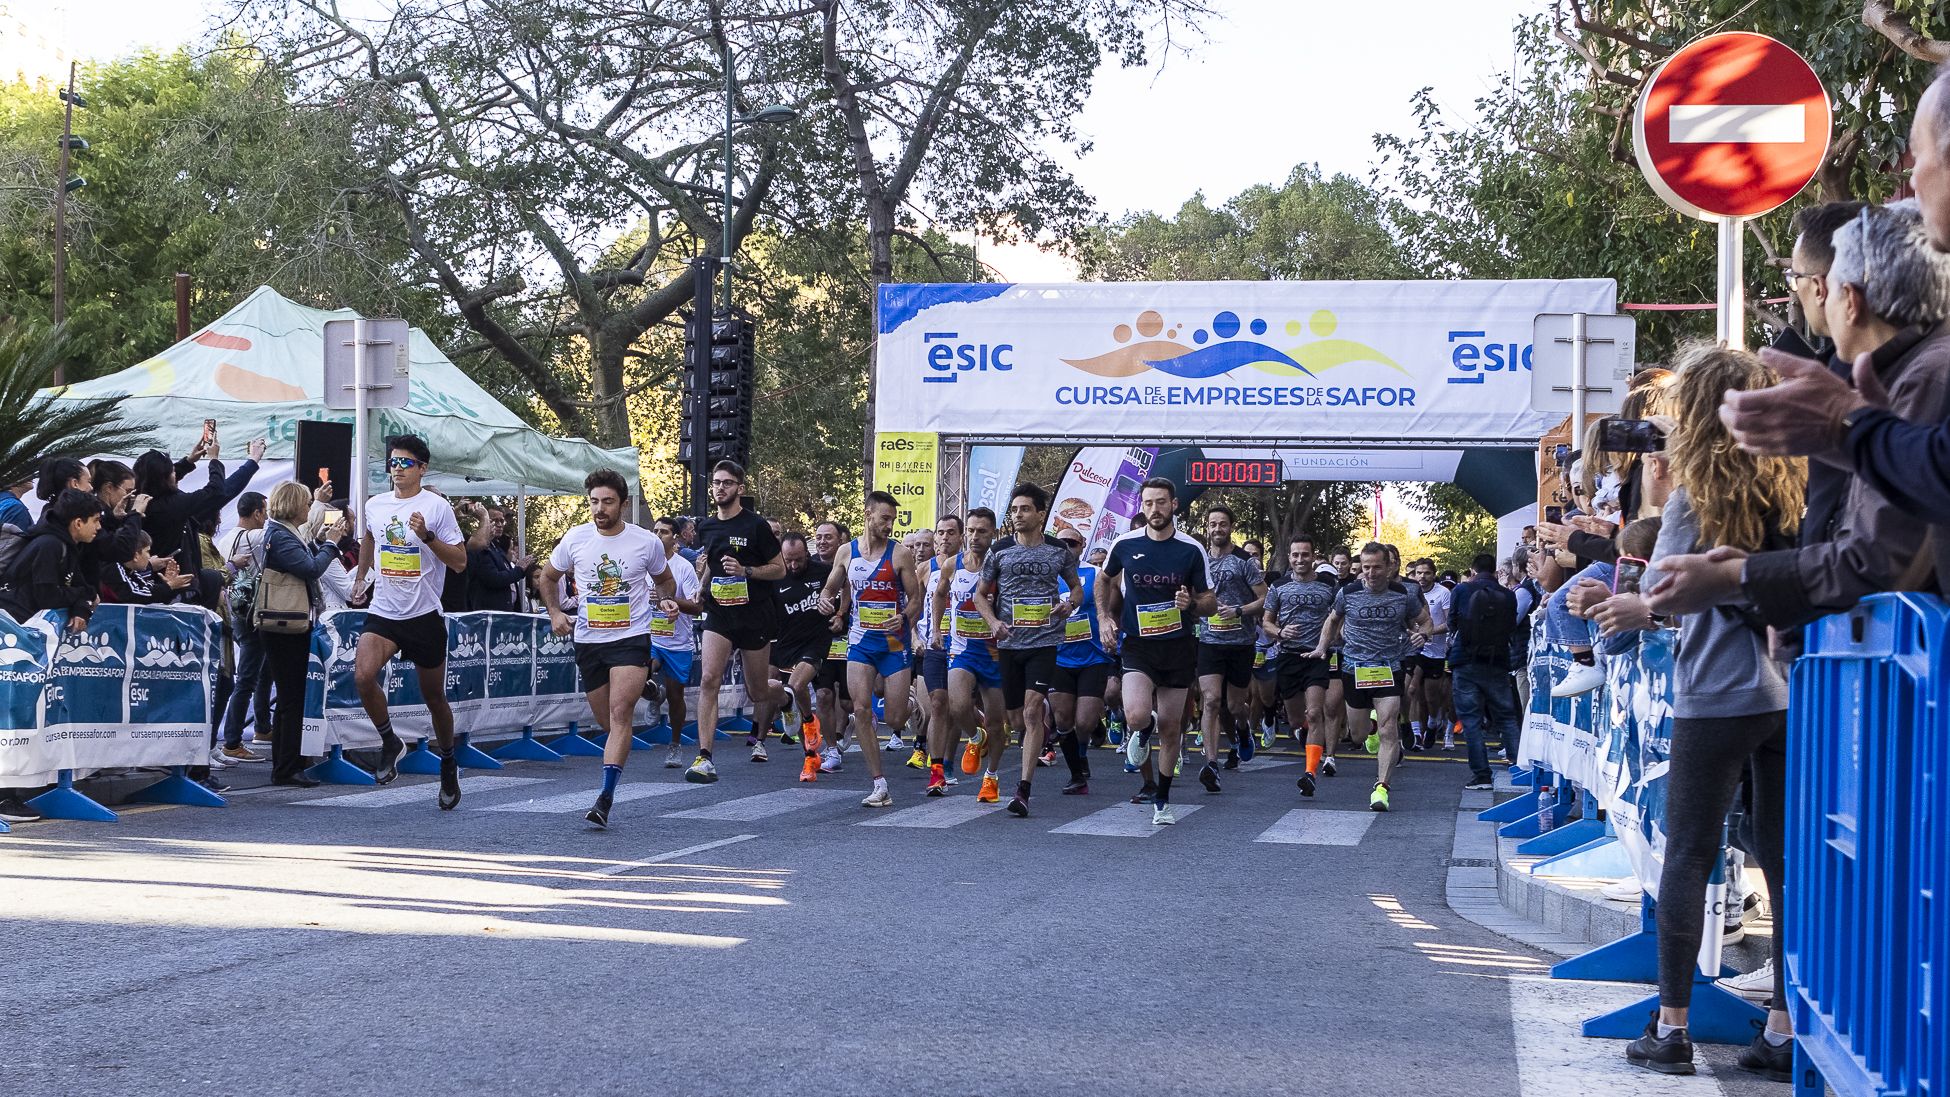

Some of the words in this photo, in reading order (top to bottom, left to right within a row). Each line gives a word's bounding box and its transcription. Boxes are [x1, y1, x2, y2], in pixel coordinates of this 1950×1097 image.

[1055, 386, 1142, 405] CURSA
[1144, 387, 1161, 396] DE
[1167, 386, 1305, 406] EMPRESES
[1306, 387, 1324, 396] DE
[1326, 387, 1416, 407] SAFOR
[1144, 396, 1166, 405] LES
[1306, 397, 1322, 406] LA
[880, 438, 914, 450] faes
[879, 461, 890, 469] RH
[895, 461, 933, 470] BAYREN
[1293, 455, 1369, 467] FUNDACIÓN
[1072, 461, 1112, 488] Dulcesol
[886, 482, 925, 496] teika
[784, 603, 800, 615] be
[103, 667, 125, 678] SAFOR
[306, 671, 325, 681] AFOR
[130, 728, 204, 740] cursaempresessafor.com
